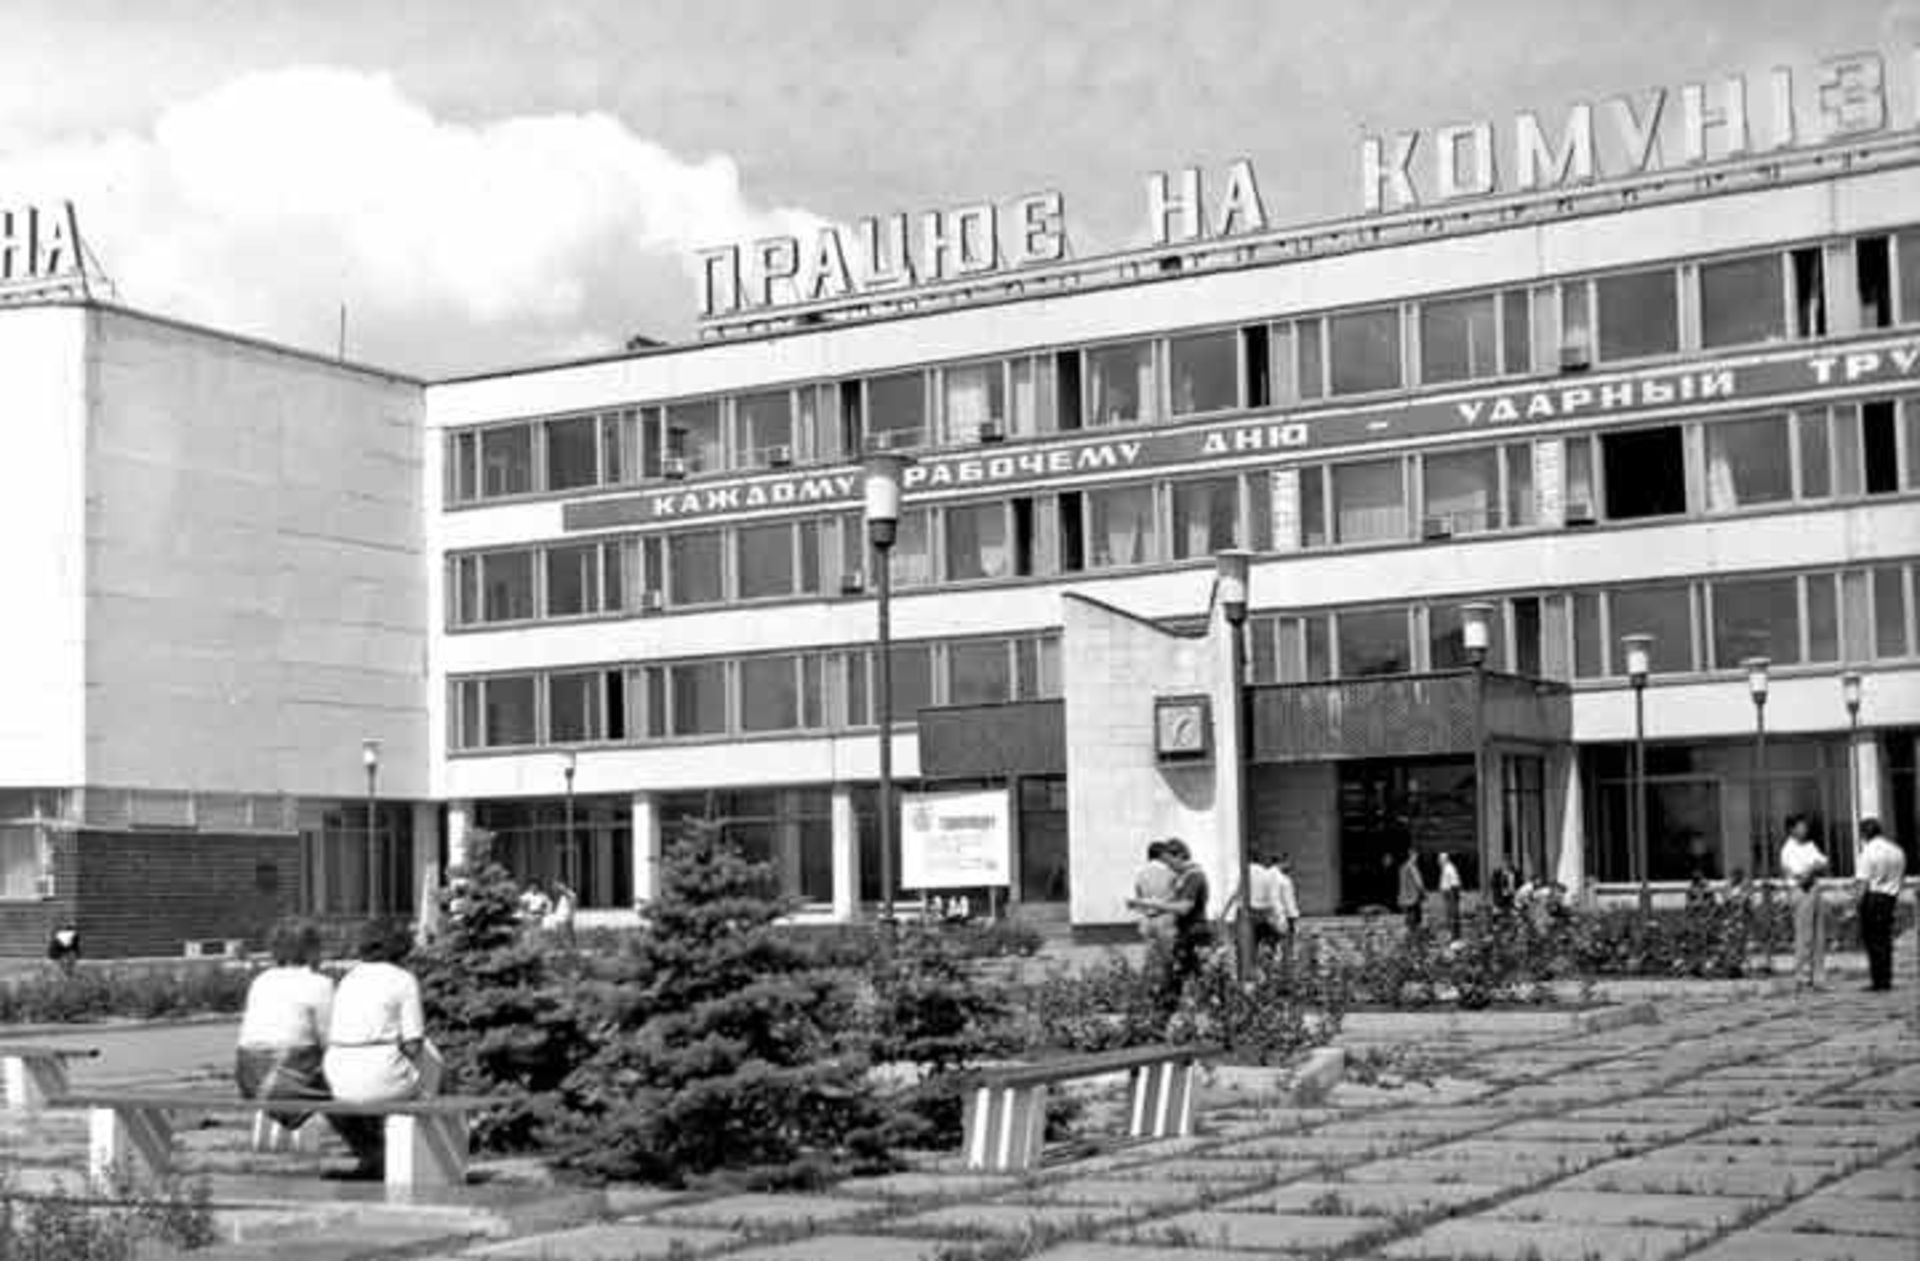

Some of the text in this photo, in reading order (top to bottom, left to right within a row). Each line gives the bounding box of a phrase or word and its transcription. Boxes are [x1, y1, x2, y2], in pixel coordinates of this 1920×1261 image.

[1149, 156, 1270, 245] НА
[1361, 50, 1920, 214] КОМУНІЗ
[654, 476, 854, 516] КАЖДОМУ
[903, 442, 1141, 488] РАБОЧЕМУ
[1202, 423, 1308, 453] ДНЮ
[1458, 369, 1735, 424] УДАРНЫЙ
[1807, 349, 1918, 384] ТРУ
